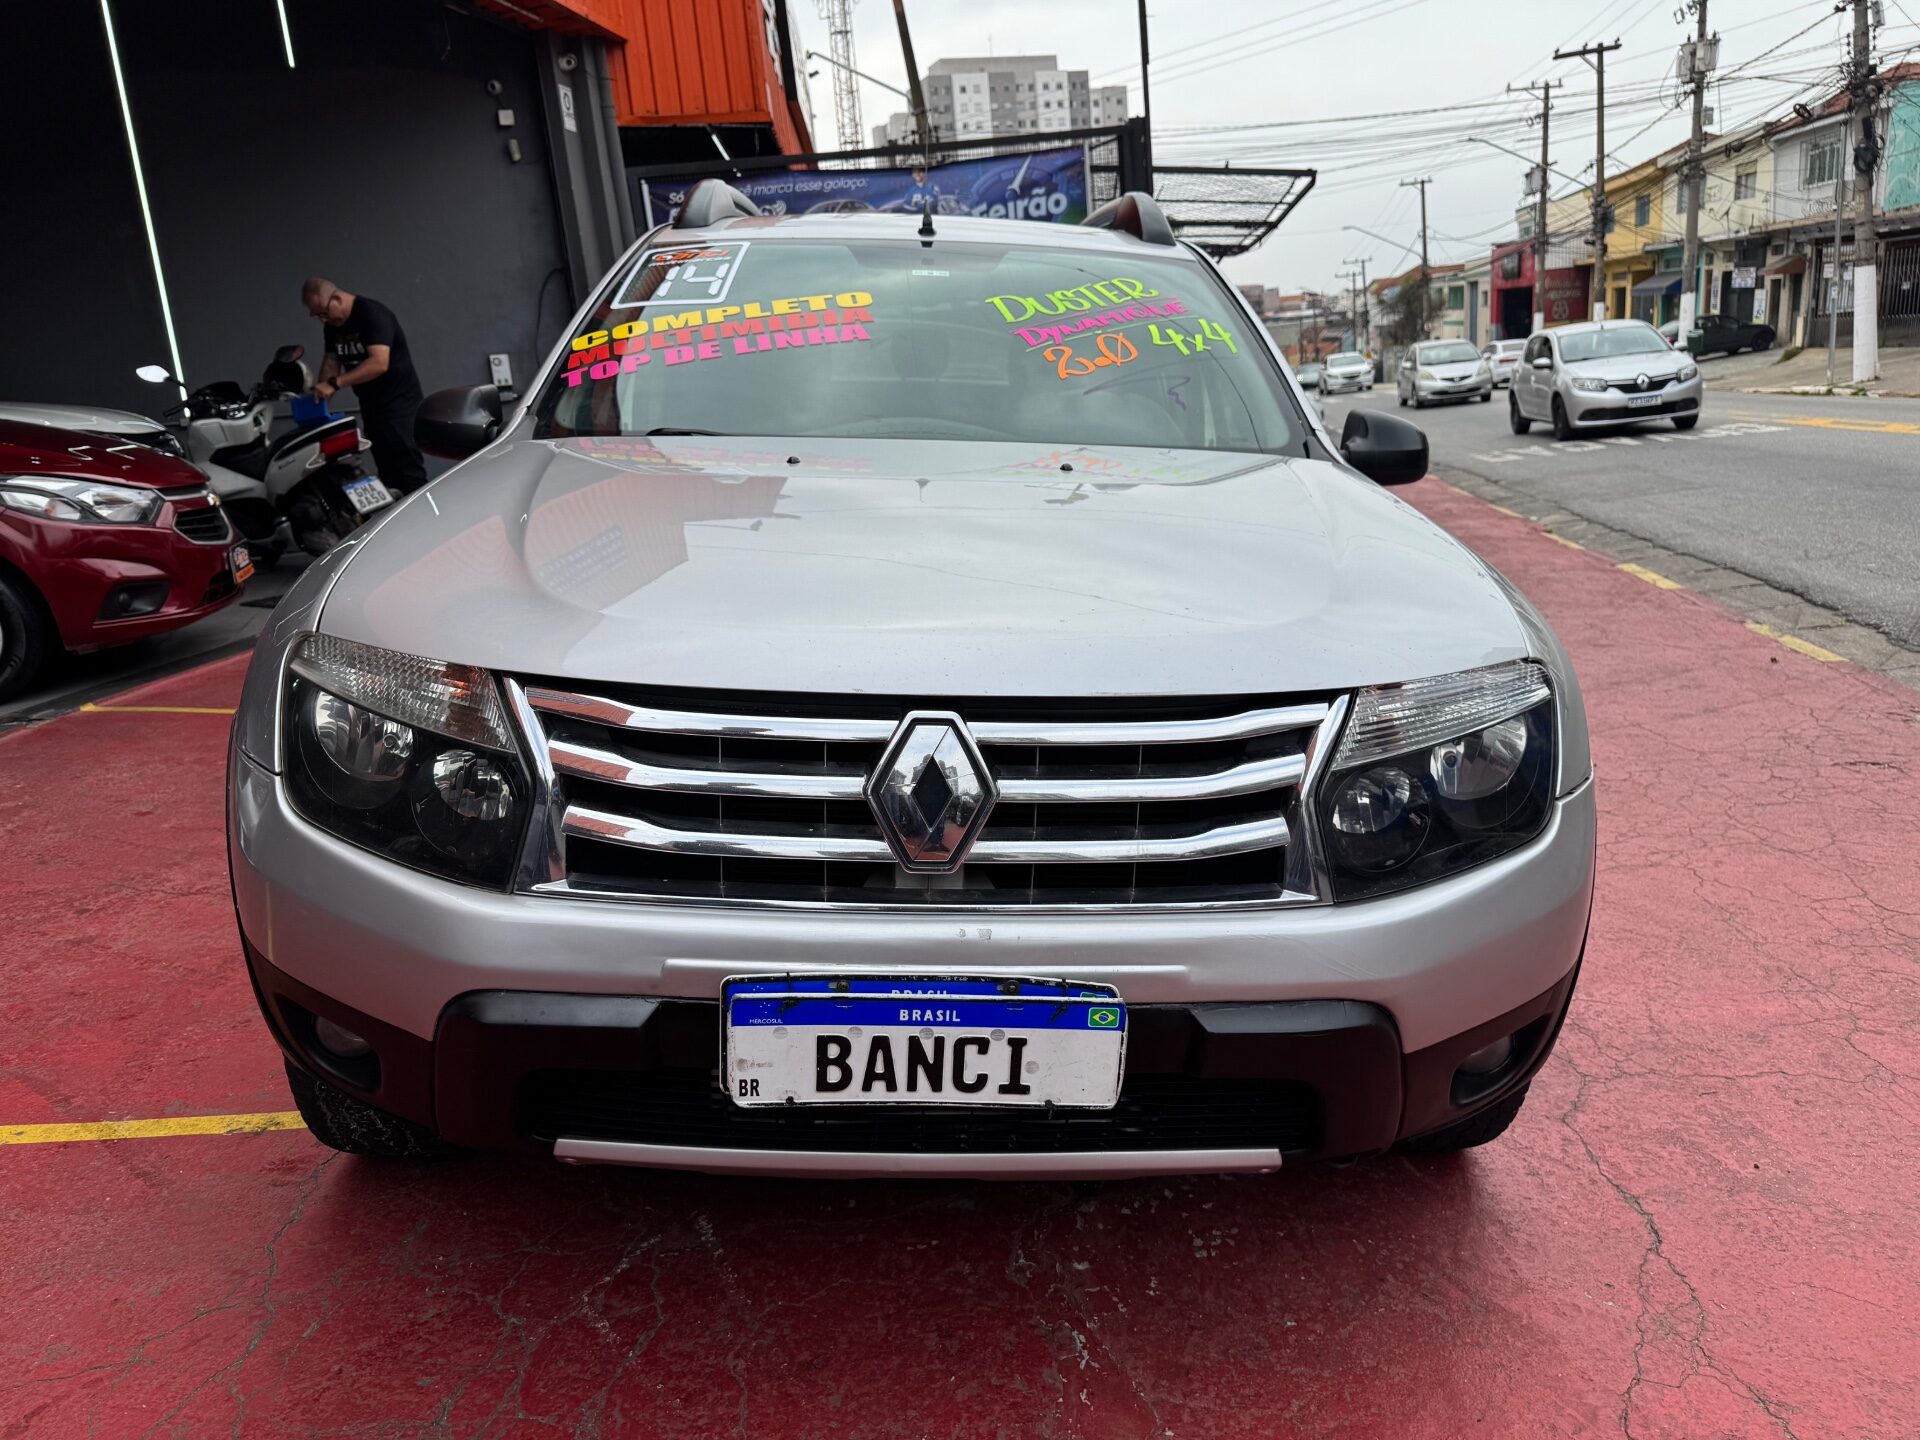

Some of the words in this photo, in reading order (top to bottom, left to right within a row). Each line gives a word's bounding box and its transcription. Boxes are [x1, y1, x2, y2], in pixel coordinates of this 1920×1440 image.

[753, 182, 794, 196] marca
[795, 179, 823, 193] esse
[657, 263, 730, 297] 14
[985, 277, 1160, 324] DUSTER
[567, 308, 875, 370] MULTIMIDIA
[571, 291, 873, 351] COMPLETO
[560, 354, 652, 388] TOP
[664, 340, 723, 366] DE
[733, 324, 872, 355] LINHA
[899, 1009, 961, 1022] BRASIL
[738, 1078, 760, 1097] BR
[815, 1033, 1031, 1095] BANCI
